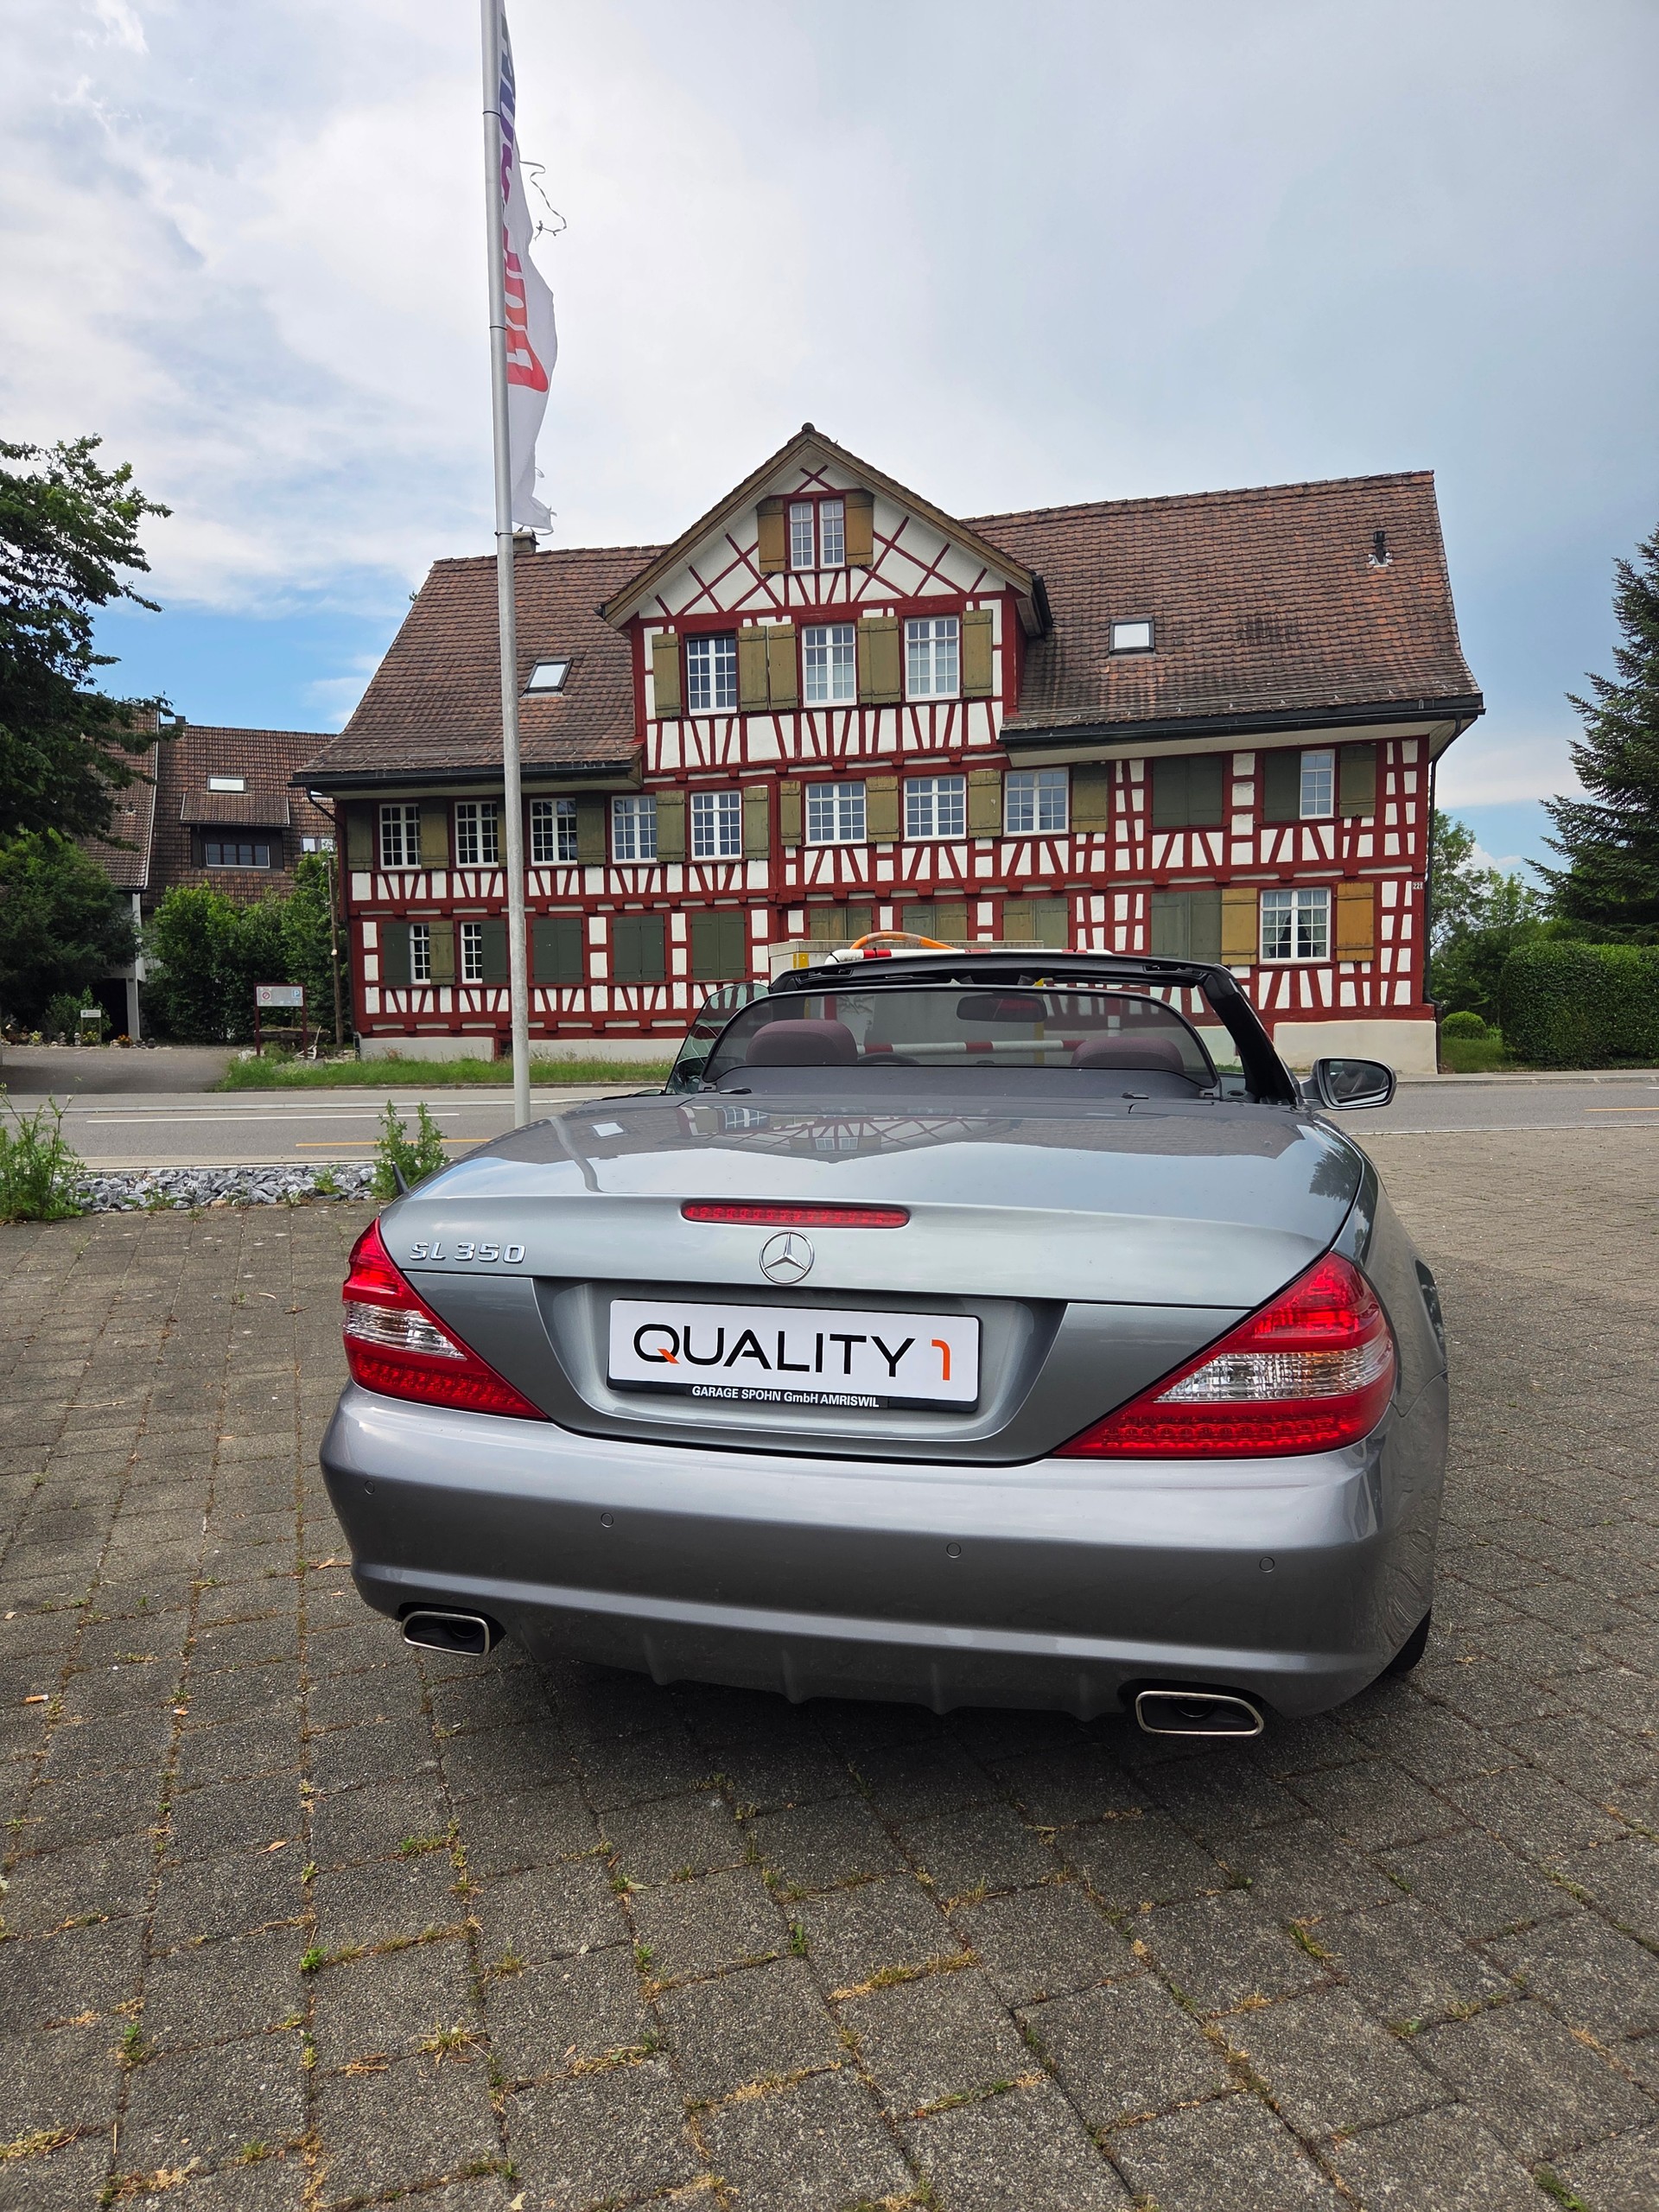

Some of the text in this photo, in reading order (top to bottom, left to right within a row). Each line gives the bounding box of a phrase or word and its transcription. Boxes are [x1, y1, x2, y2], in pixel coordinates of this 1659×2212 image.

[410, 1242, 526, 1264] SL 350
[633, 1324, 916, 1377] QUALITY
[691, 1385, 880, 1408] GARAGE SPOHN GmbH AMRISWIL
